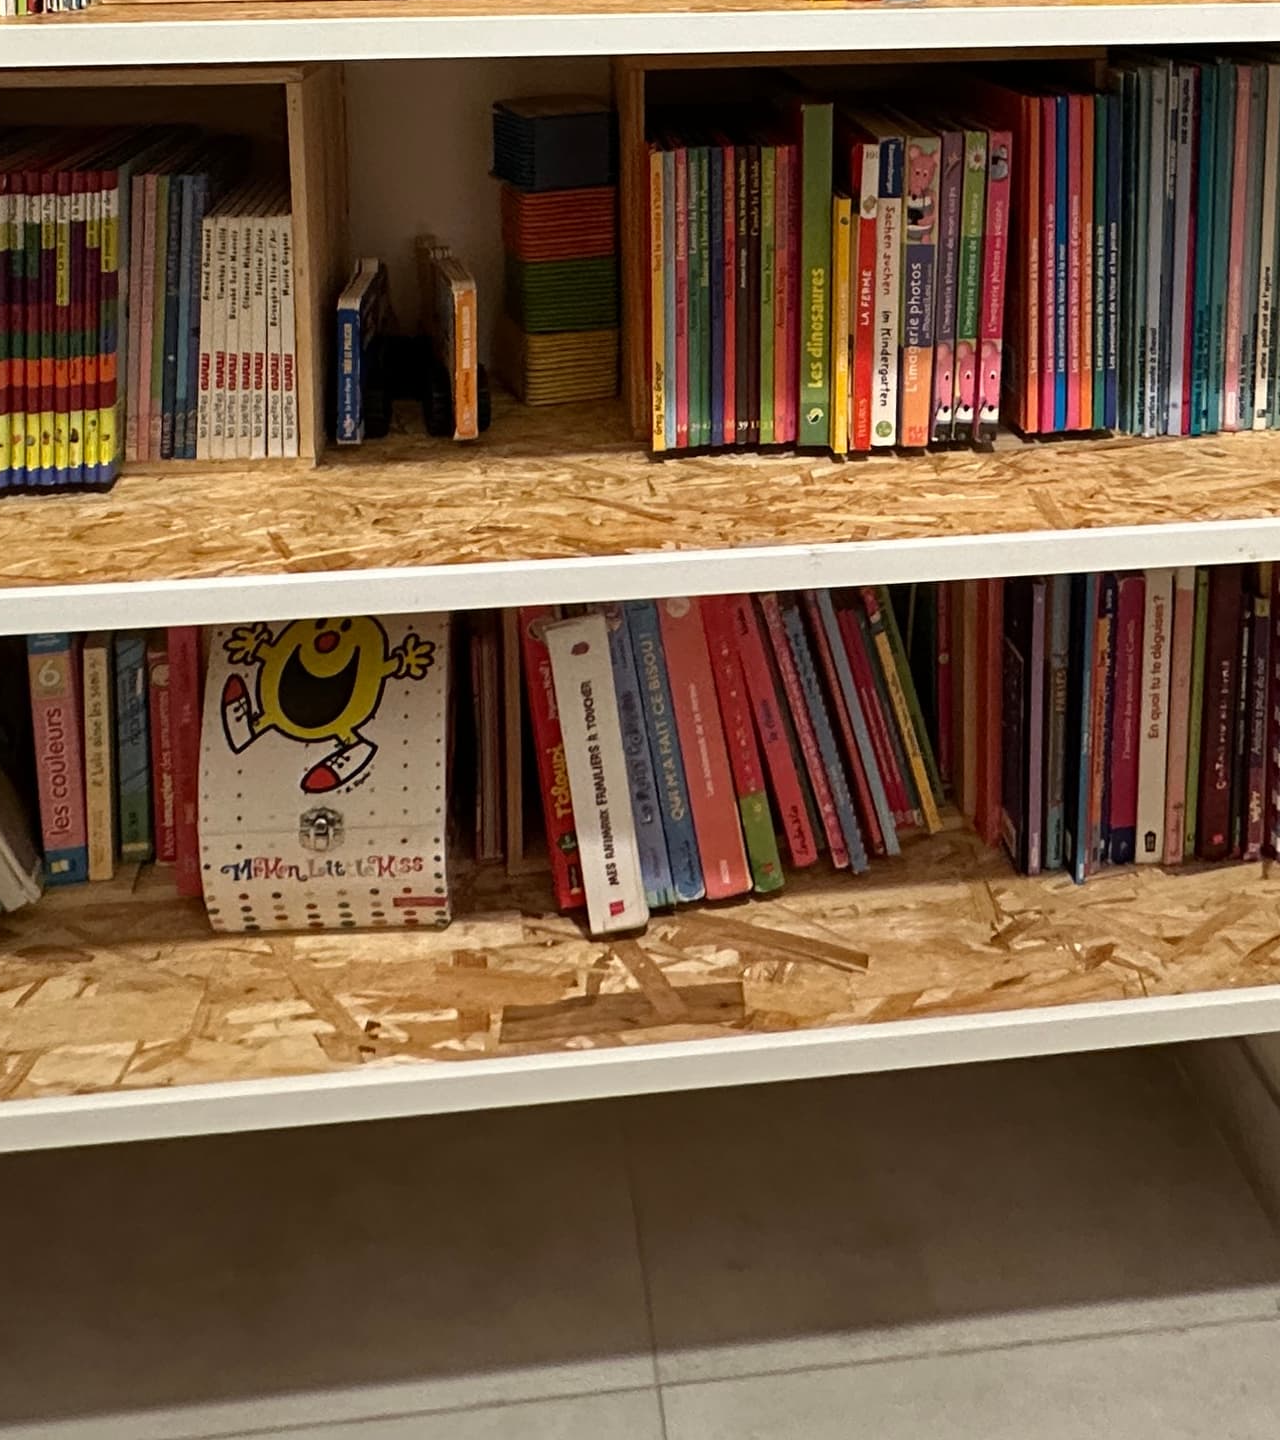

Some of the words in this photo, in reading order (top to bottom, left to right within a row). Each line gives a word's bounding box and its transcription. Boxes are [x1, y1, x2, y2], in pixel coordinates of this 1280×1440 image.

[860, 269, 873, 307] FERME
[907, 262, 923, 315] photos
[805, 267, 825, 358] dinosaures
[877, 325, 894, 408] Kindergarten
[904, 317, 923, 393] L'imagerie
[806, 360, 825, 389] Les
[653, 413, 665, 436] Greg
[1149, 604, 1168, 660] déguises
[1149, 675, 1161, 691] tu
[580, 680, 597, 731] TOUCHER
[651, 694, 666, 716] CE
[1148, 693, 1163, 721] quoi
[657, 721, 675, 757] FAIT
[1147, 723, 1160, 739] En
[46, 706, 65, 800] couleurs
[587, 745, 607, 806] FAMILIERS
[50, 804, 71, 837] les
[667, 790, 685, 821] QUI
[604, 862, 620, 886] MES
